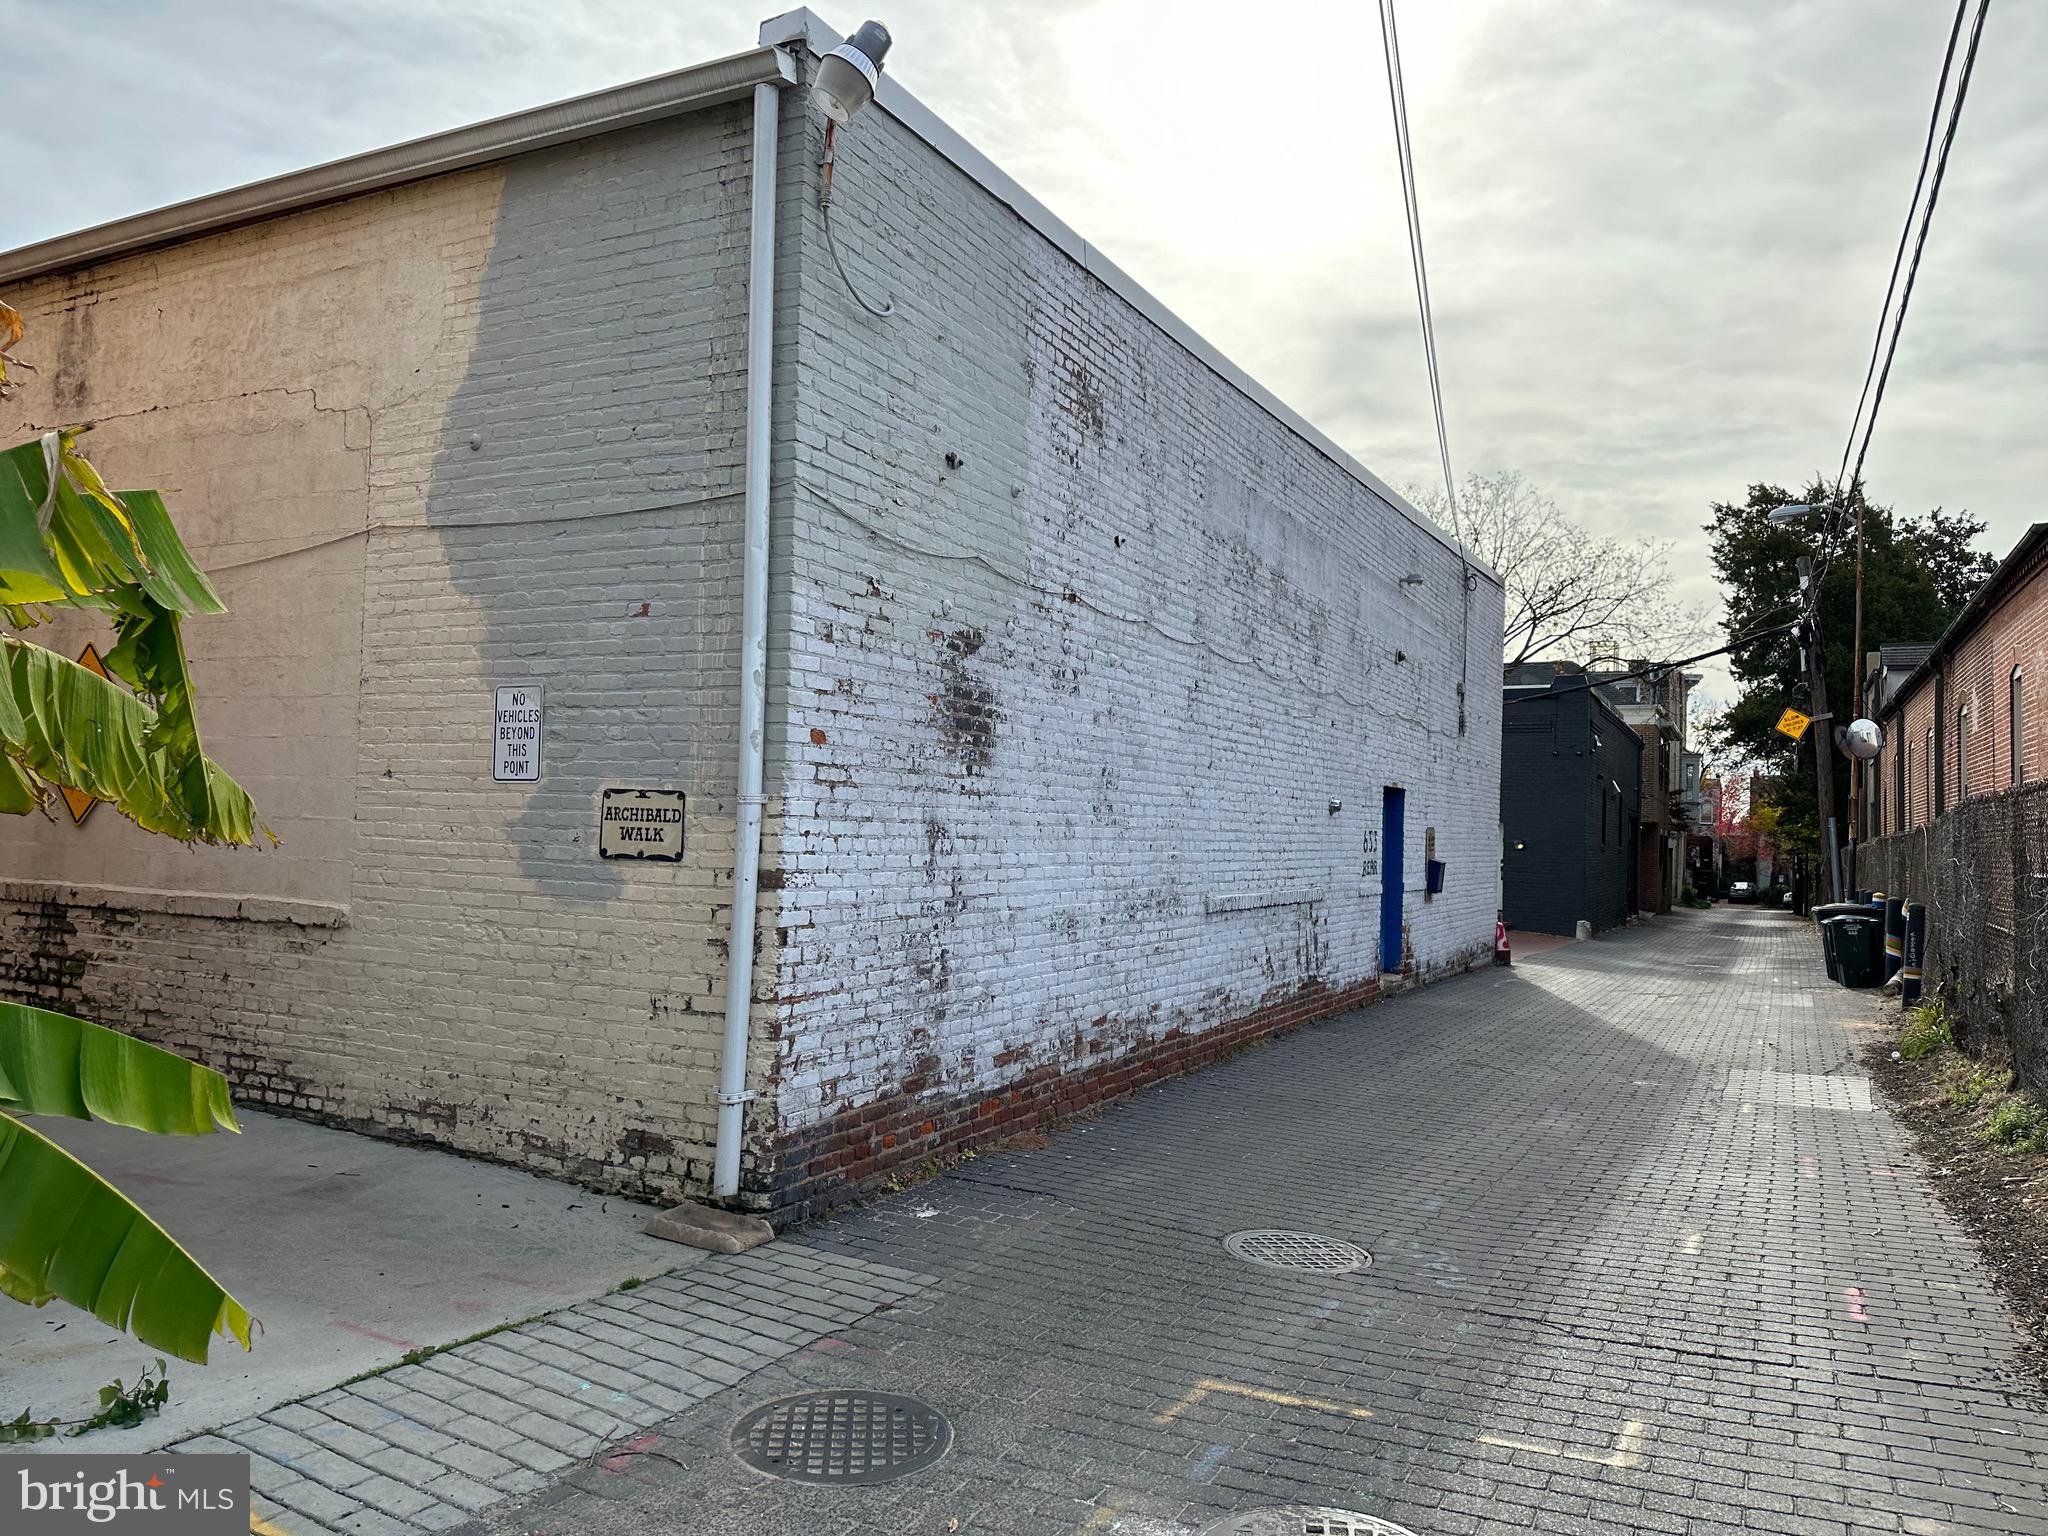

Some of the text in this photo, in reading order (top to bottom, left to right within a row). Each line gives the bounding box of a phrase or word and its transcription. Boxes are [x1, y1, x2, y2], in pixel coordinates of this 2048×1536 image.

[512, 692, 526, 706] NO
[497, 709, 540, 723] VEHICLES
[500, 726, 535, 740] BEYOND
[507, 743, 527, 757] THIS
[503, 760, 530, 774] POINT
[604, 806, 682, 823] ARCHIBALD
[619, 826, 664, 842] WALK
